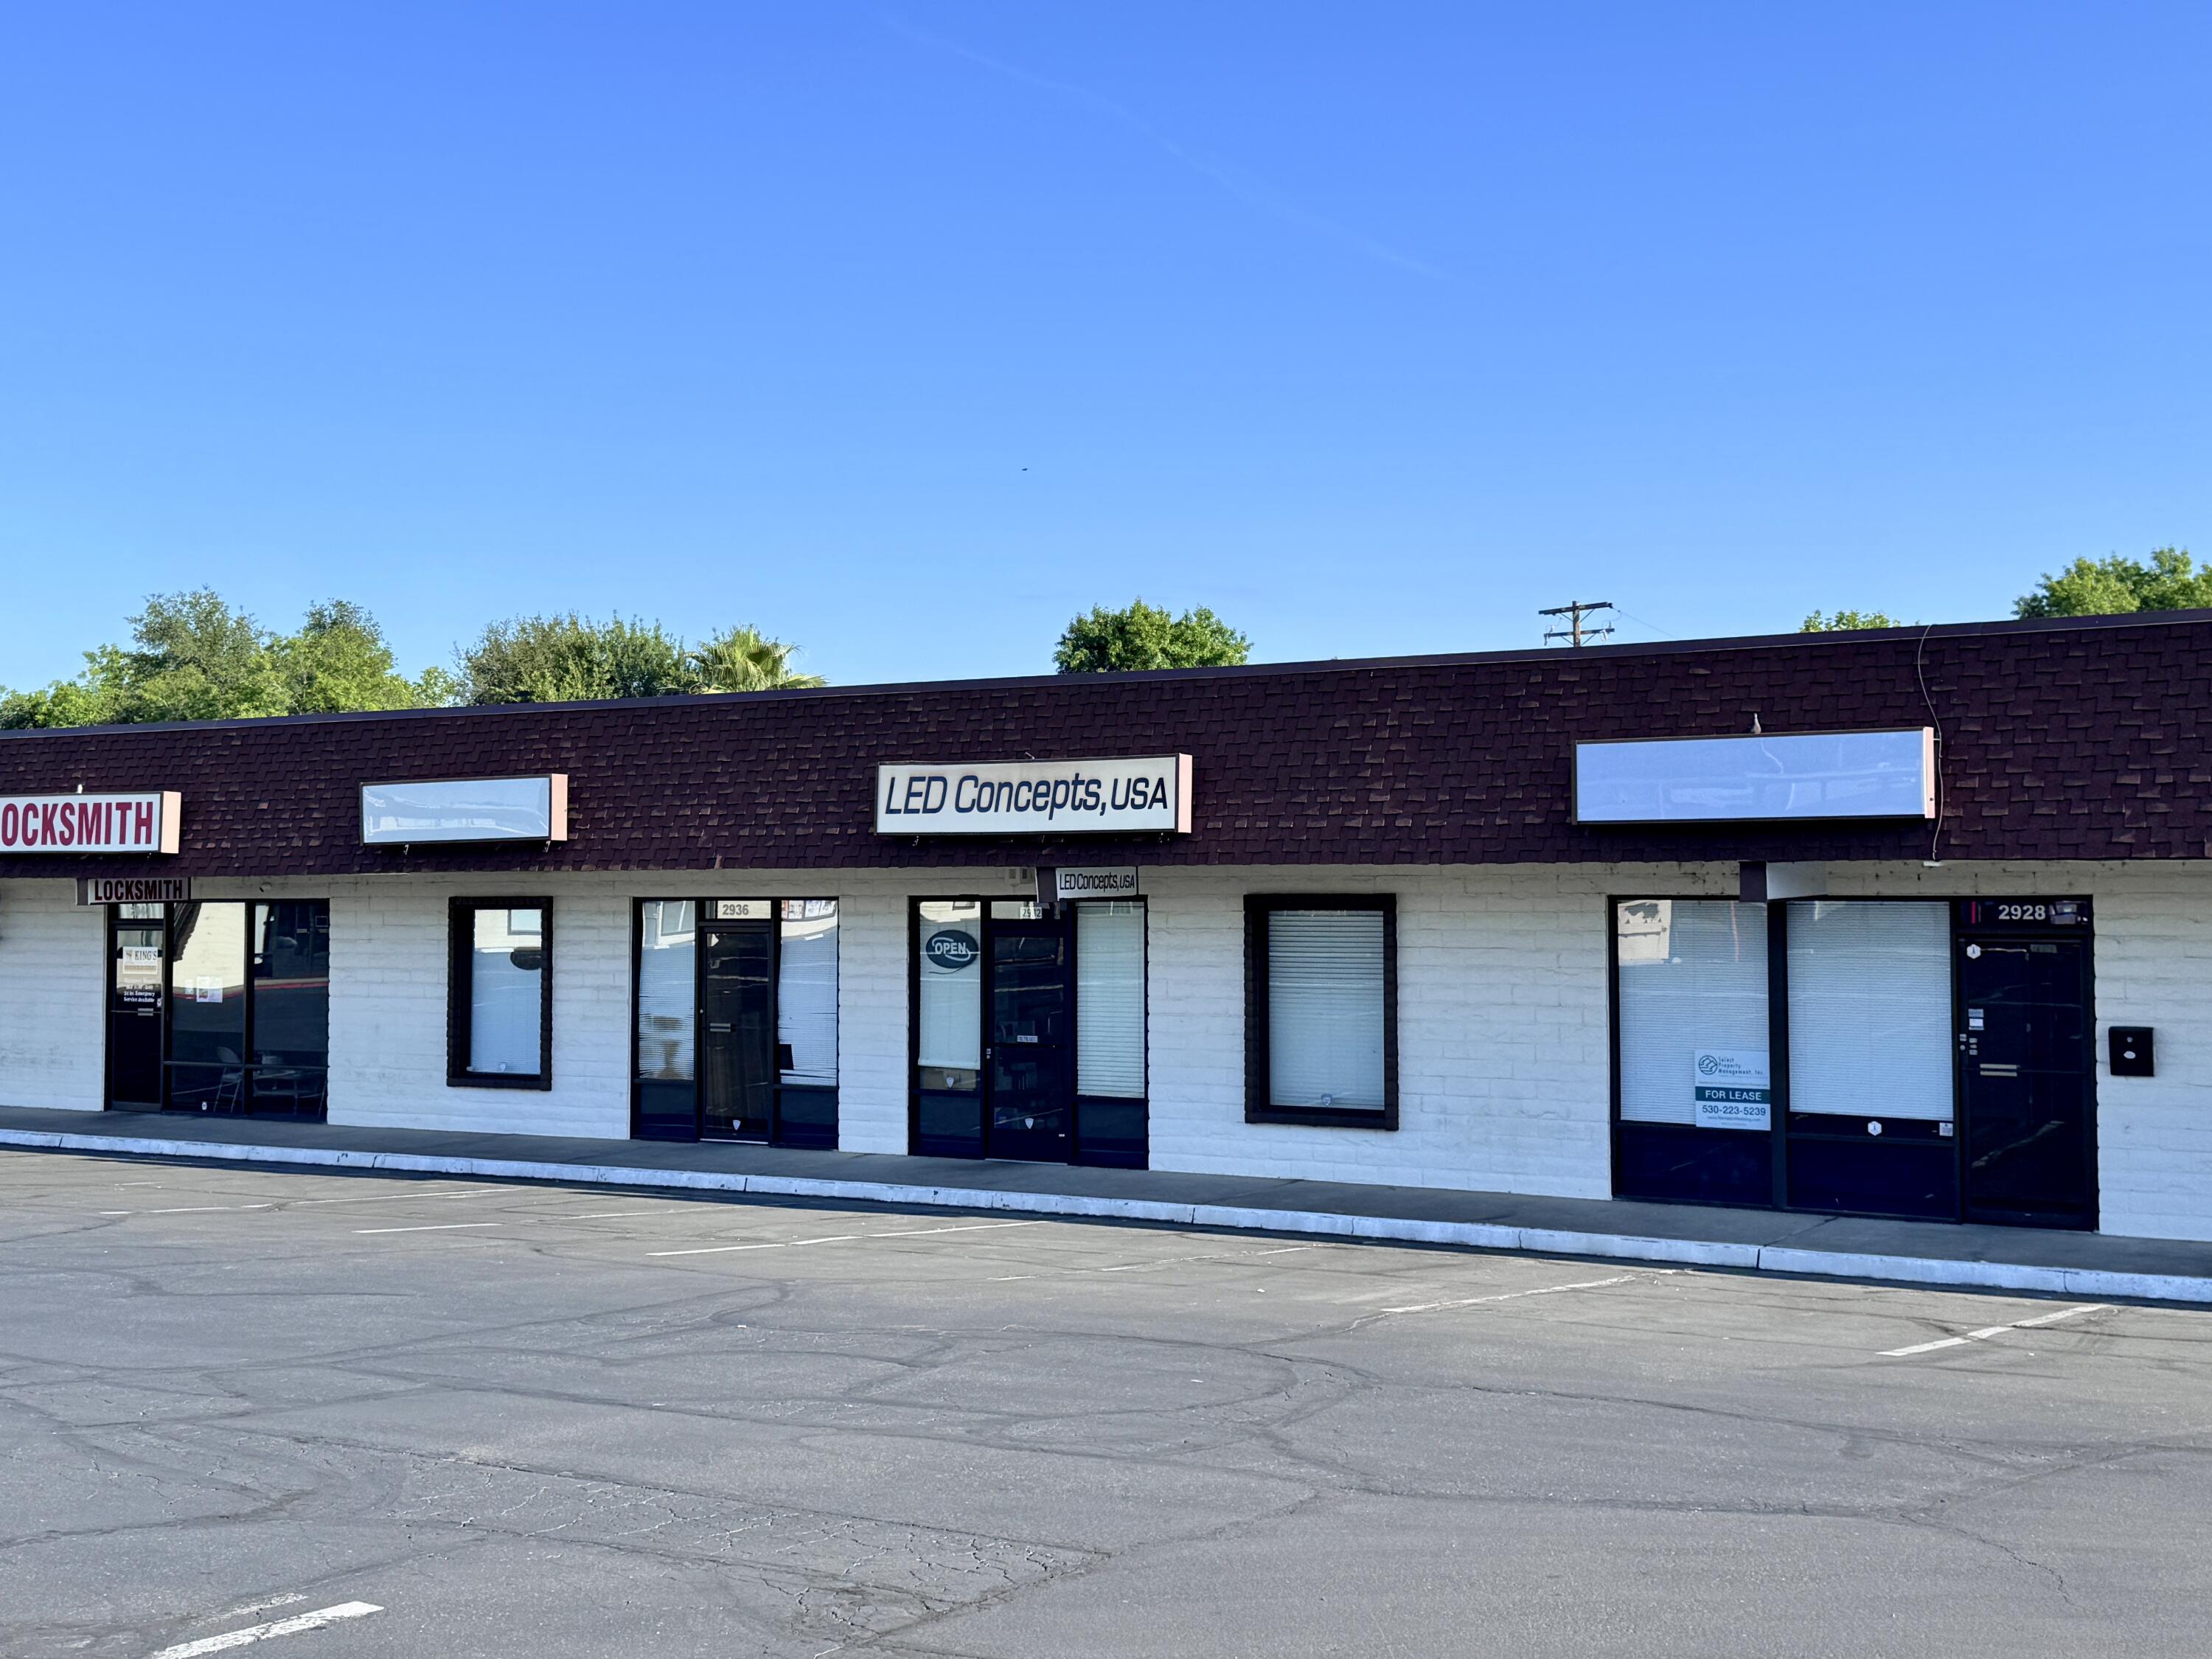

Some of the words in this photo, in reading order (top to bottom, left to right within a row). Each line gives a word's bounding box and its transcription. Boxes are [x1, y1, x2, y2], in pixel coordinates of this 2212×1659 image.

[885, 776, 948, 814] LED
[1060, 873, 1077, 890] LED
[94, 879, 183, 901] LOCKSMITH
[722, 904, 749, 915] 2936
[1023, 908, 1041, 917] 292
[1998, 905, 2046, 920] 2928
[934, 942, 966, 955] OPEN
[1705, 1090, 1726, 1099] FOR
[1729, 1091, 1762, 1101] LEASE
[1702, 1105, 1766, 1116] 530-223-5239
